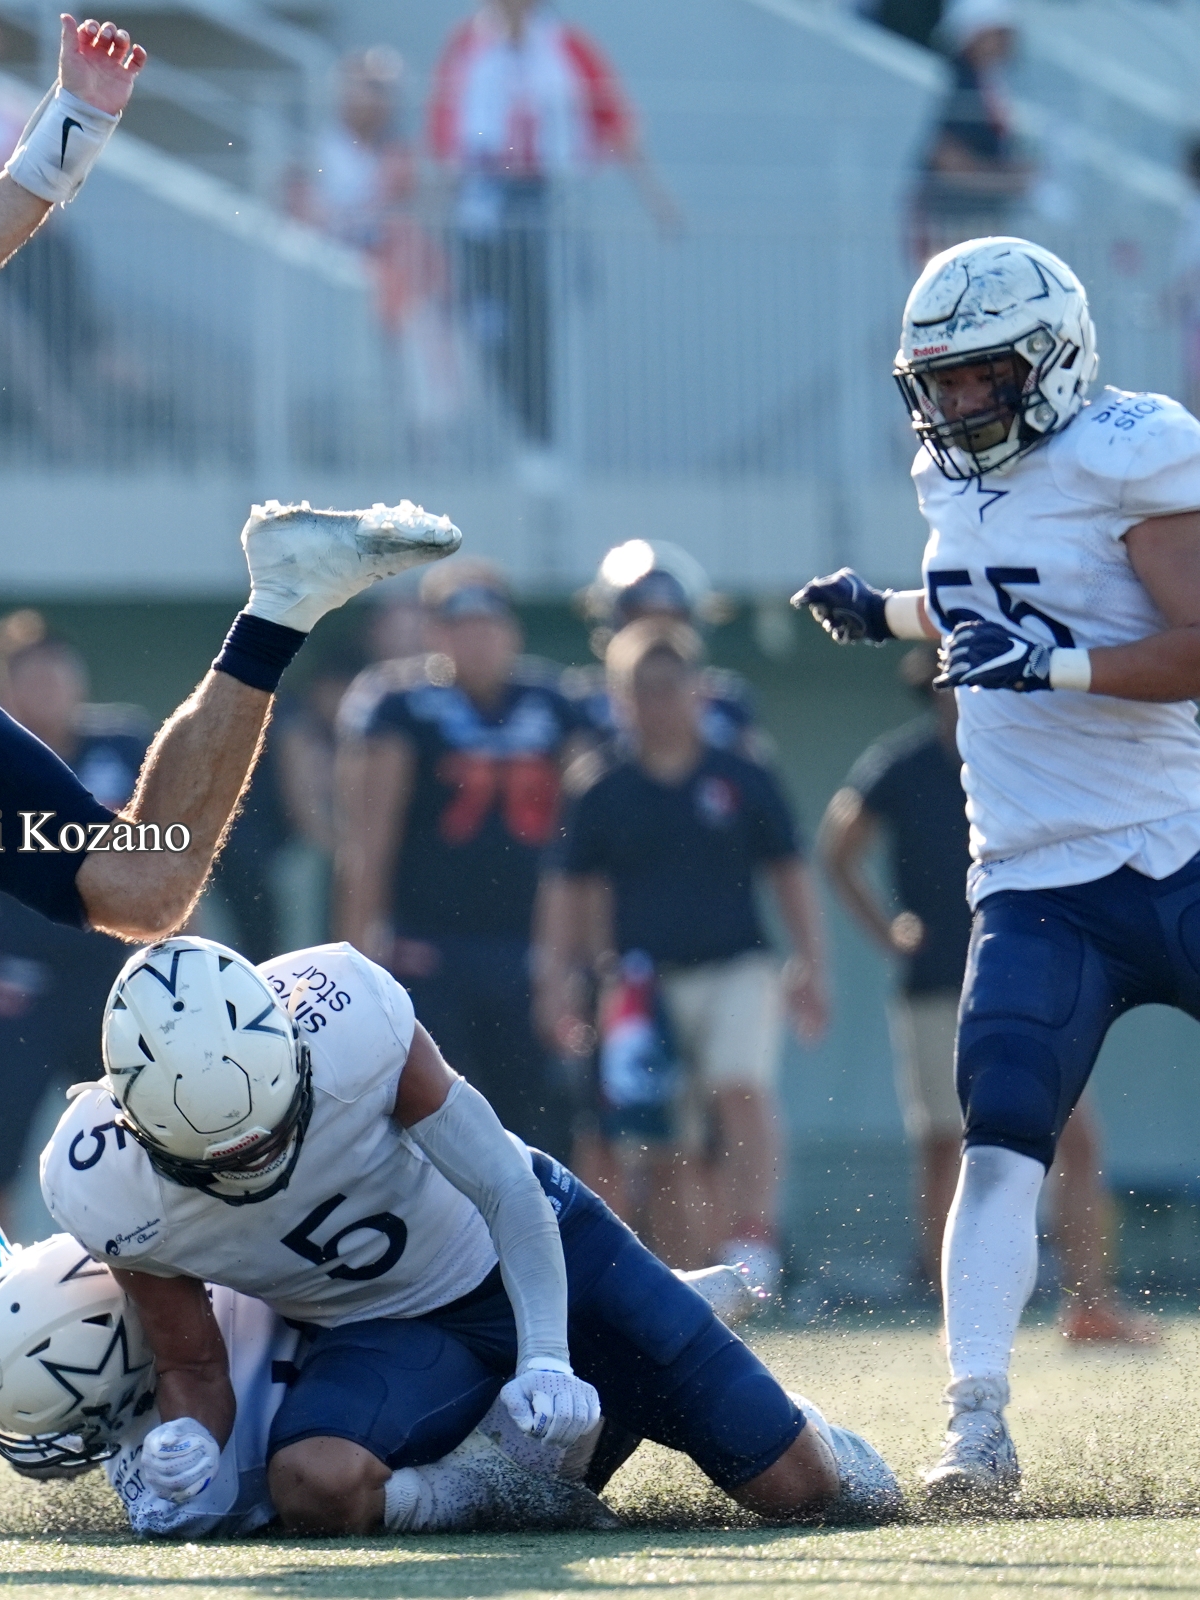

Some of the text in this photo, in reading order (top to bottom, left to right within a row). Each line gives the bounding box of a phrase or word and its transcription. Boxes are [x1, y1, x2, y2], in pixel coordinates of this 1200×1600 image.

[912, 344, 948, 357] Riddell
[928, 567, 1076, 649] 55
[292, 965, 352, 1012] star
[68, 1119, 127, 1172] 5
[280, 1193, 408, 1281] 5
